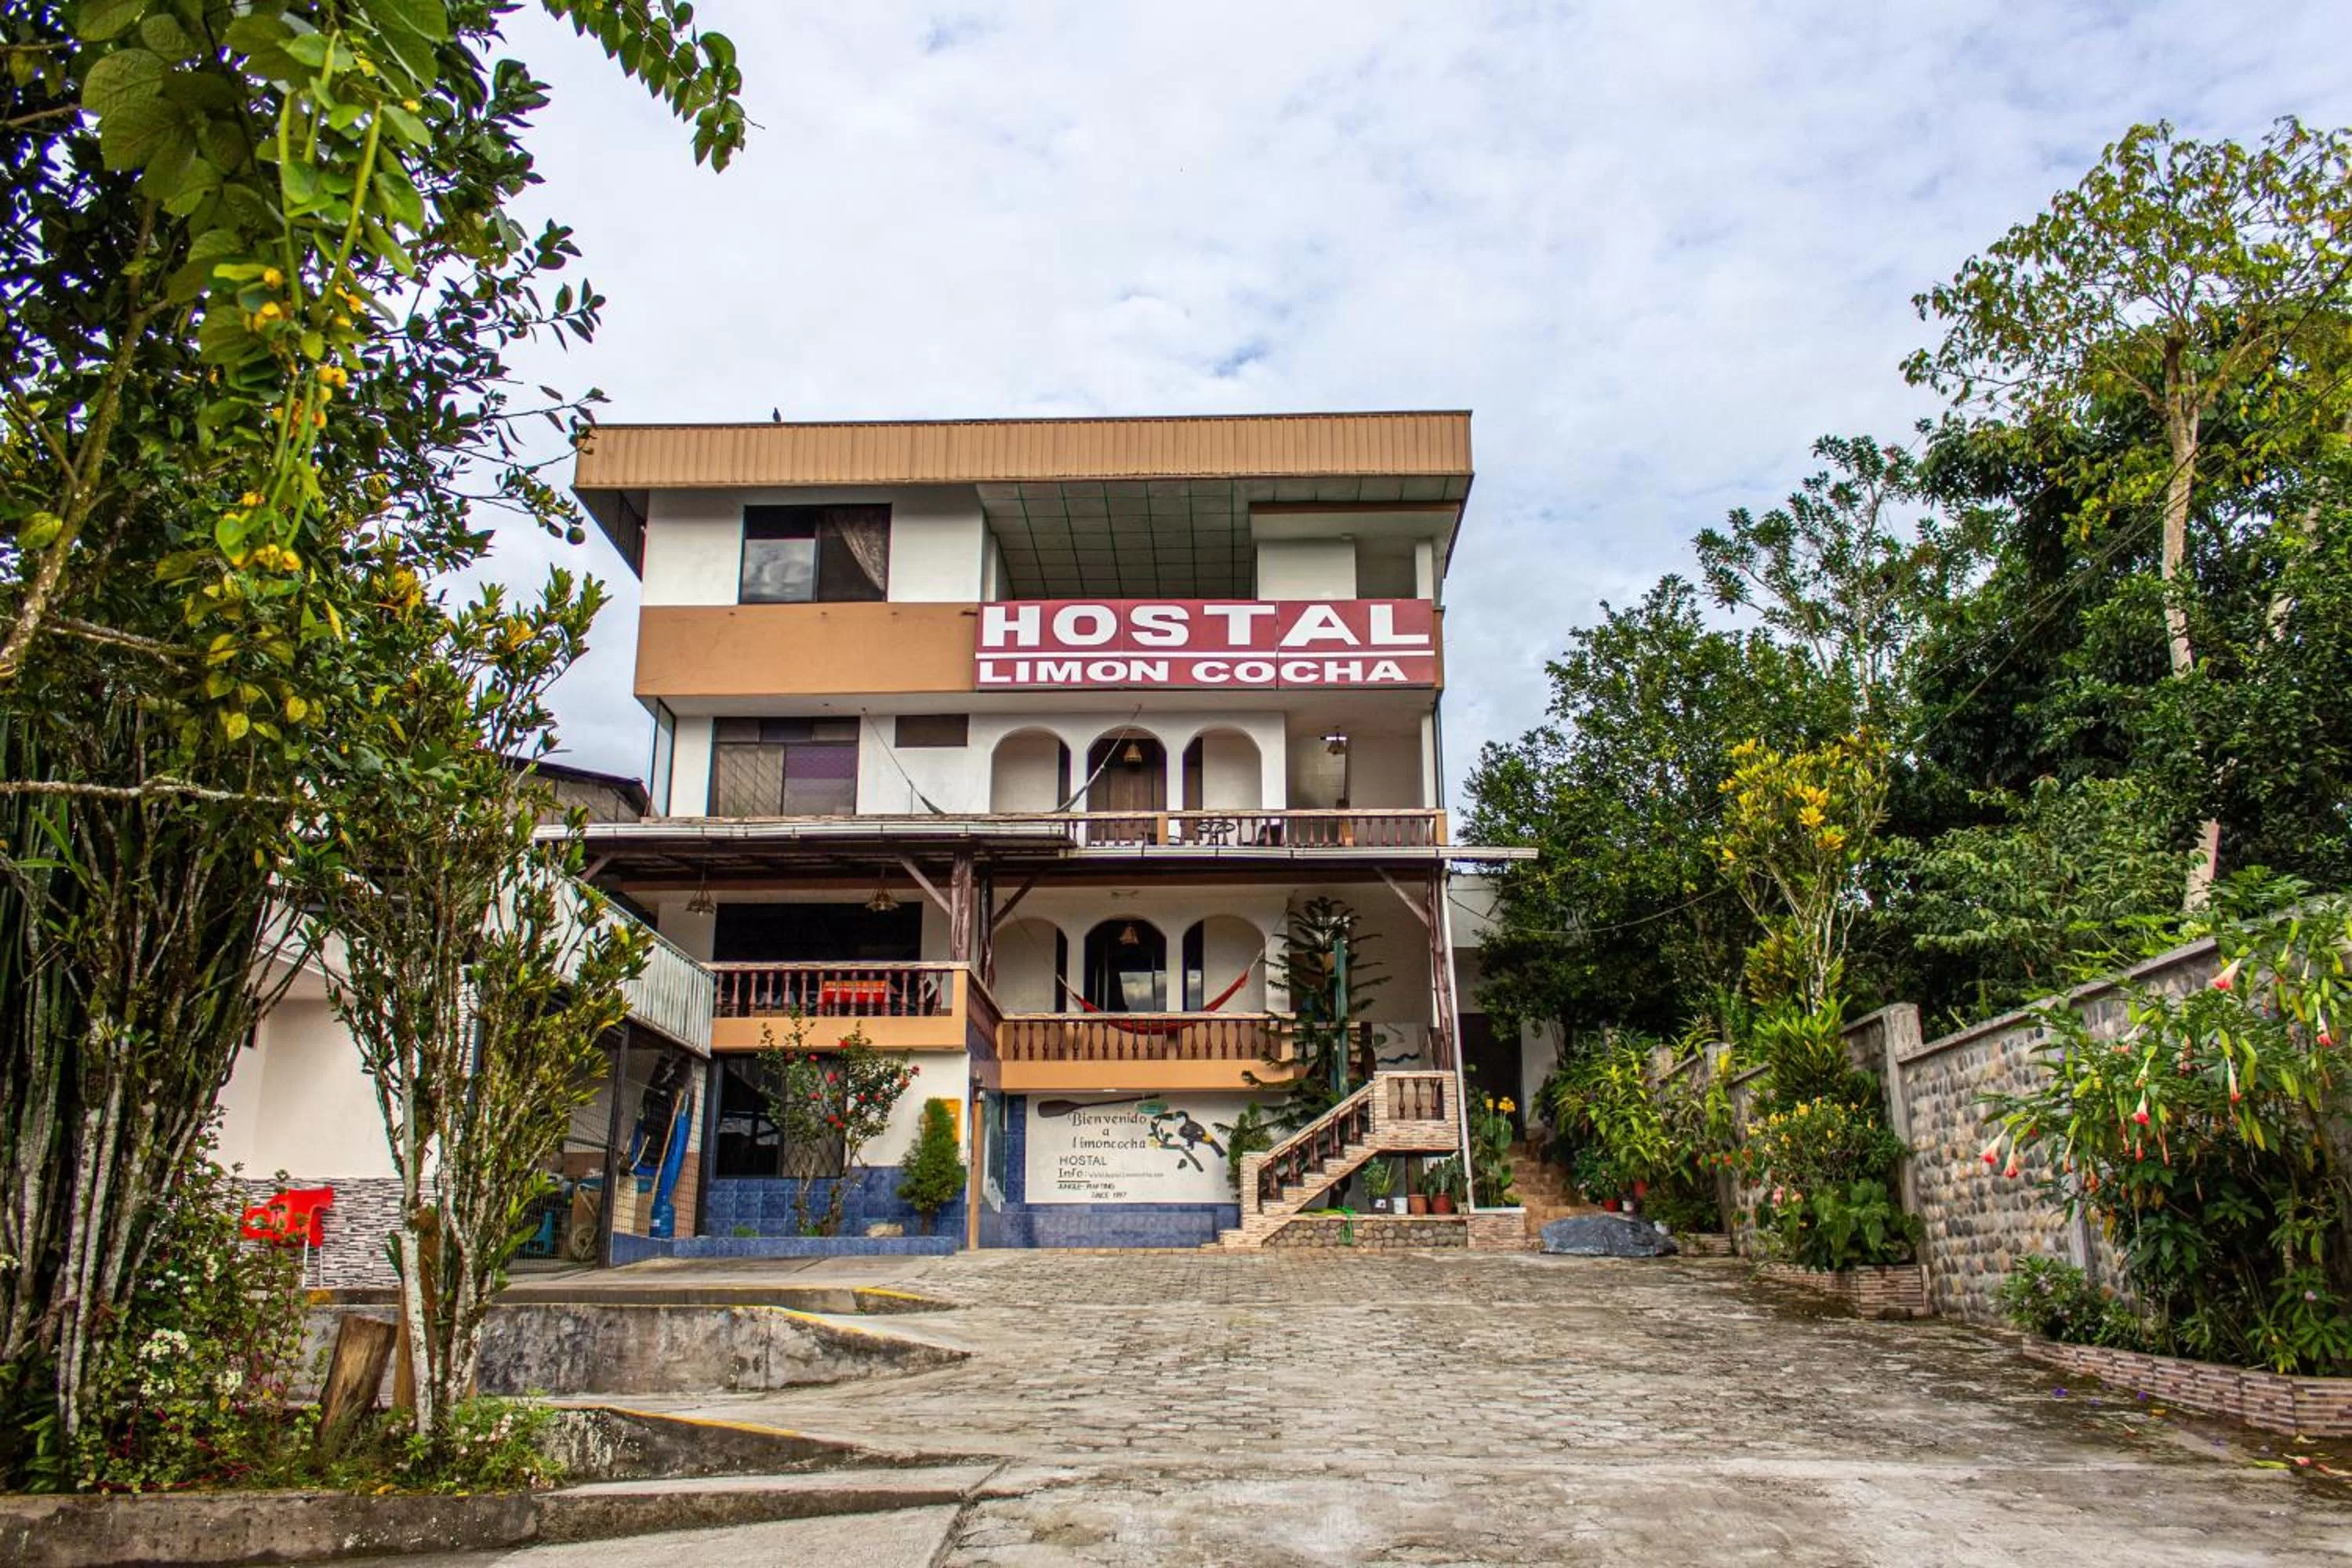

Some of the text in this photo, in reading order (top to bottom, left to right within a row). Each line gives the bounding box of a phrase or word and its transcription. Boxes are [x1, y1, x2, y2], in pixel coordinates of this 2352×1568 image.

[982, 604, 1429, 647] HOSTAL
[978, 659, 1408, 683] LIMON COCHA
[1069, 1112, 1147, 1126] Bienvenido
[1058, 1155, 1108, 1166] HOSTAL
